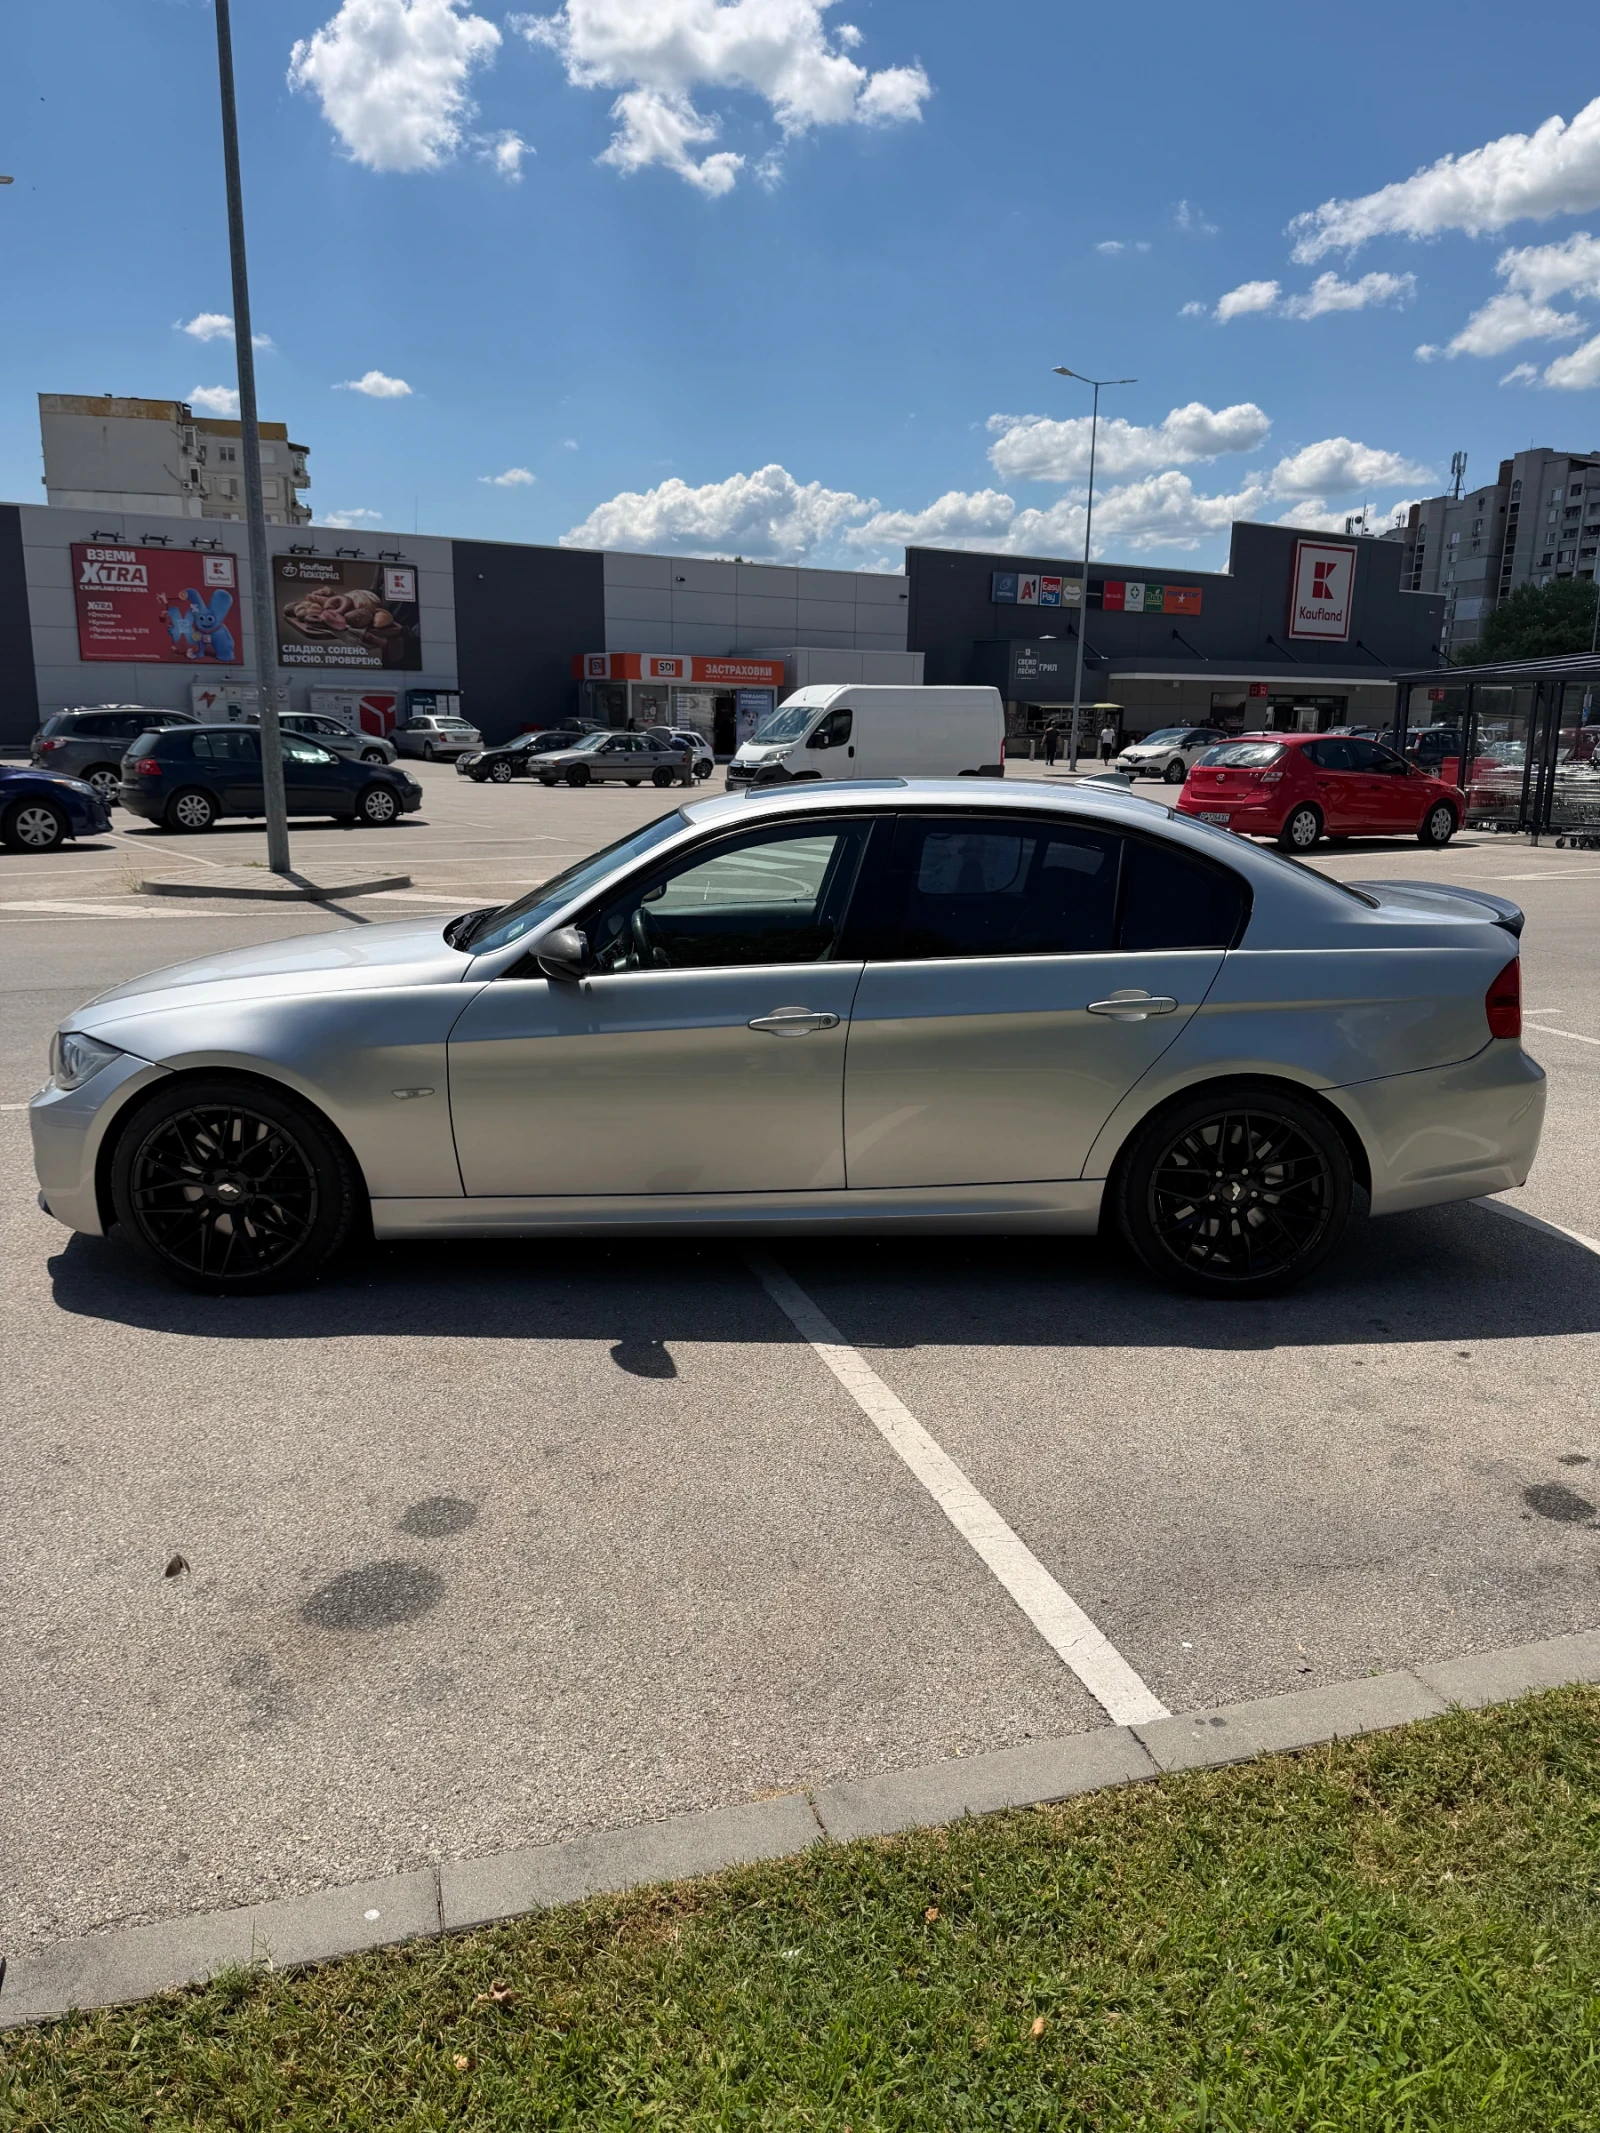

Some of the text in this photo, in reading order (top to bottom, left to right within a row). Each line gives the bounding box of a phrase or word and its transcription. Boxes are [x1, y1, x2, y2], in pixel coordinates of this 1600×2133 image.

[86, 548, 137, 563] ВЗЕМИ
[299, 562, 334, 572] Kaufland
[79, 561, 149, 586] XTRA
[299, 570, 340, 581] пекарна
[1020, 579, 1037, 600] A1
[1042, 581, 1060, 594] Easy
[1042, 591, 1056, 603] Pay
[1299, 606, 1343, 622] Kaufland
[282, 644, 369, 656] СЛАДКО. СОЛЕНО.
[282, 654, 383, 666] ВКУСНО. ПРОВЕРЕНО.
[659, 662, 675, 672] SDI
[705, 664, 773, 677] ЗАСТРАХОВКИ
[1039, 663, 1058, 672] ГРИЛ
